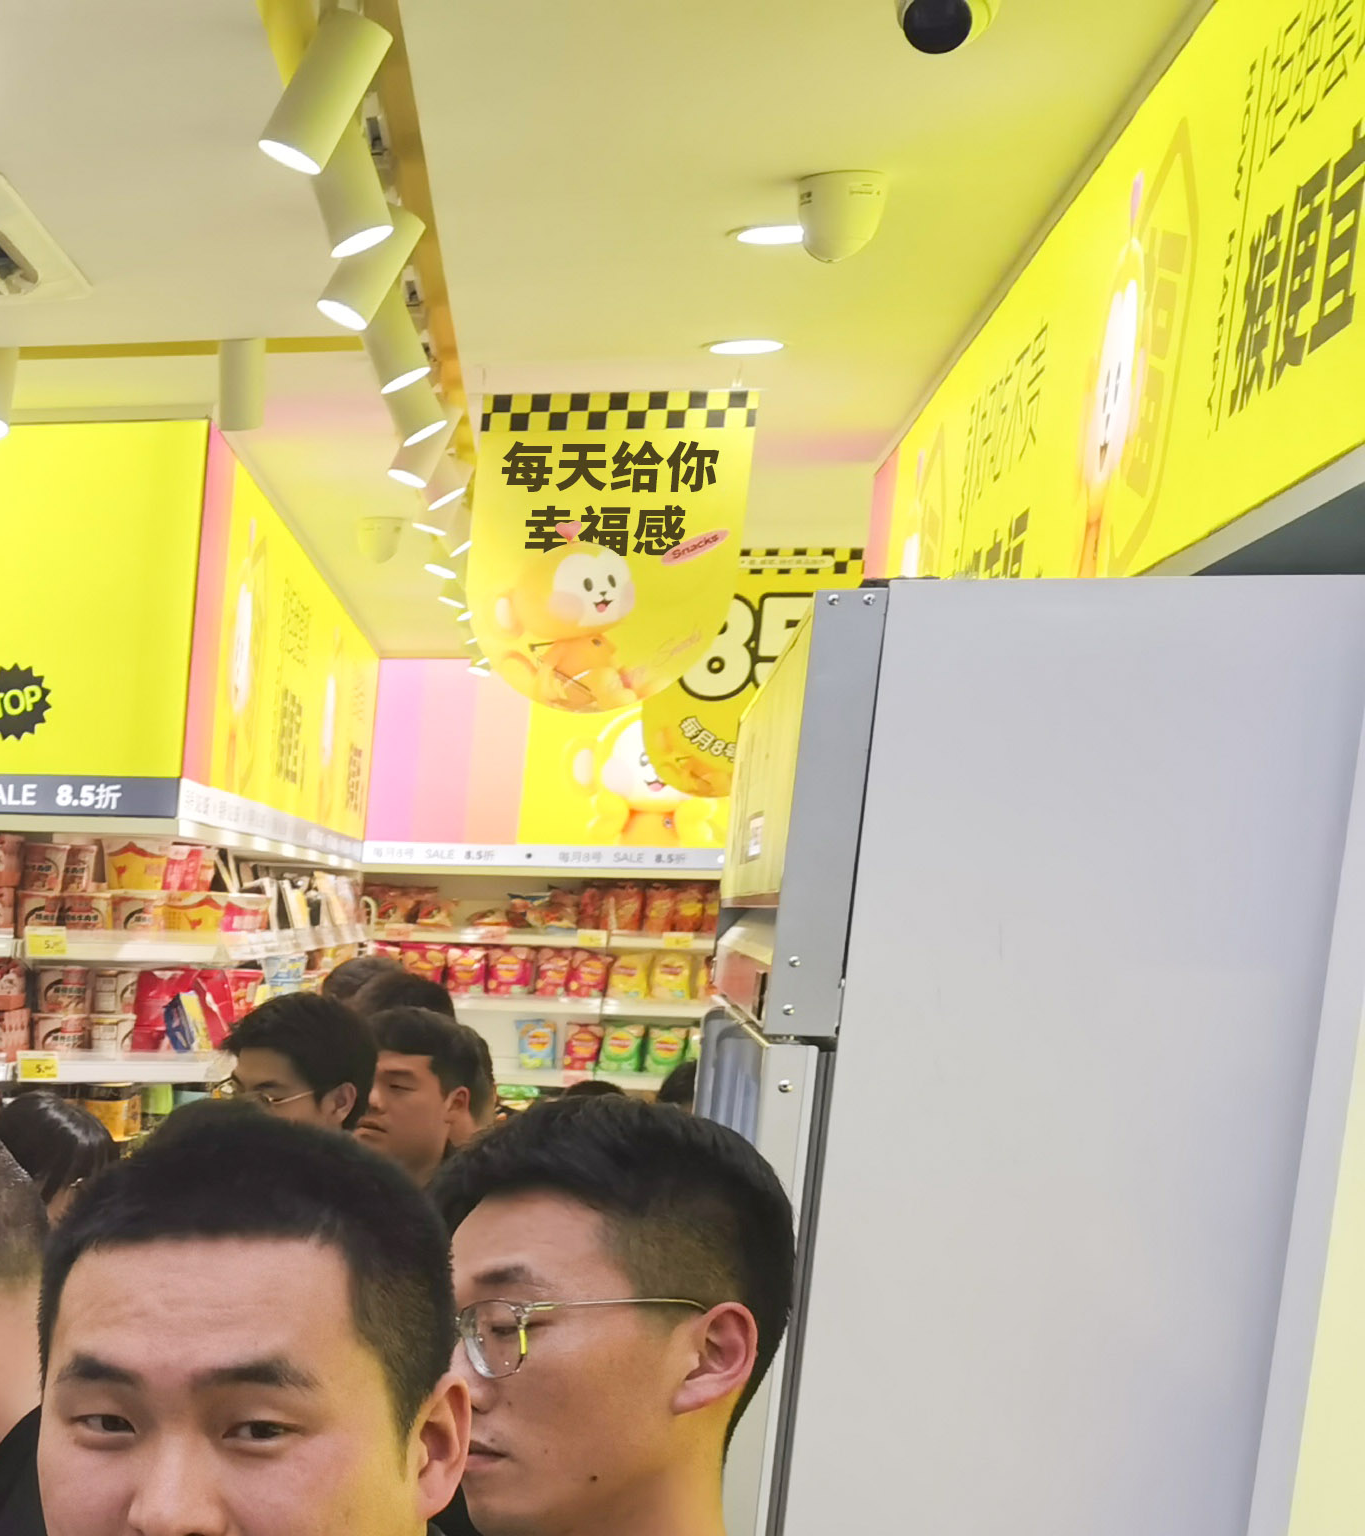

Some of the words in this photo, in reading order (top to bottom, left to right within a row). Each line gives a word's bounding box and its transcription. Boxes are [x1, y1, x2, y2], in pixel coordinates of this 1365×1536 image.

[501, 440, 719, 493] 每天给你
[524, 505, 687, 558] 幸福感
[56, 784, 122, 810] 8.5折
[424, 848, 455, 860] SALE
[612, 852, 646, 864] SALE
